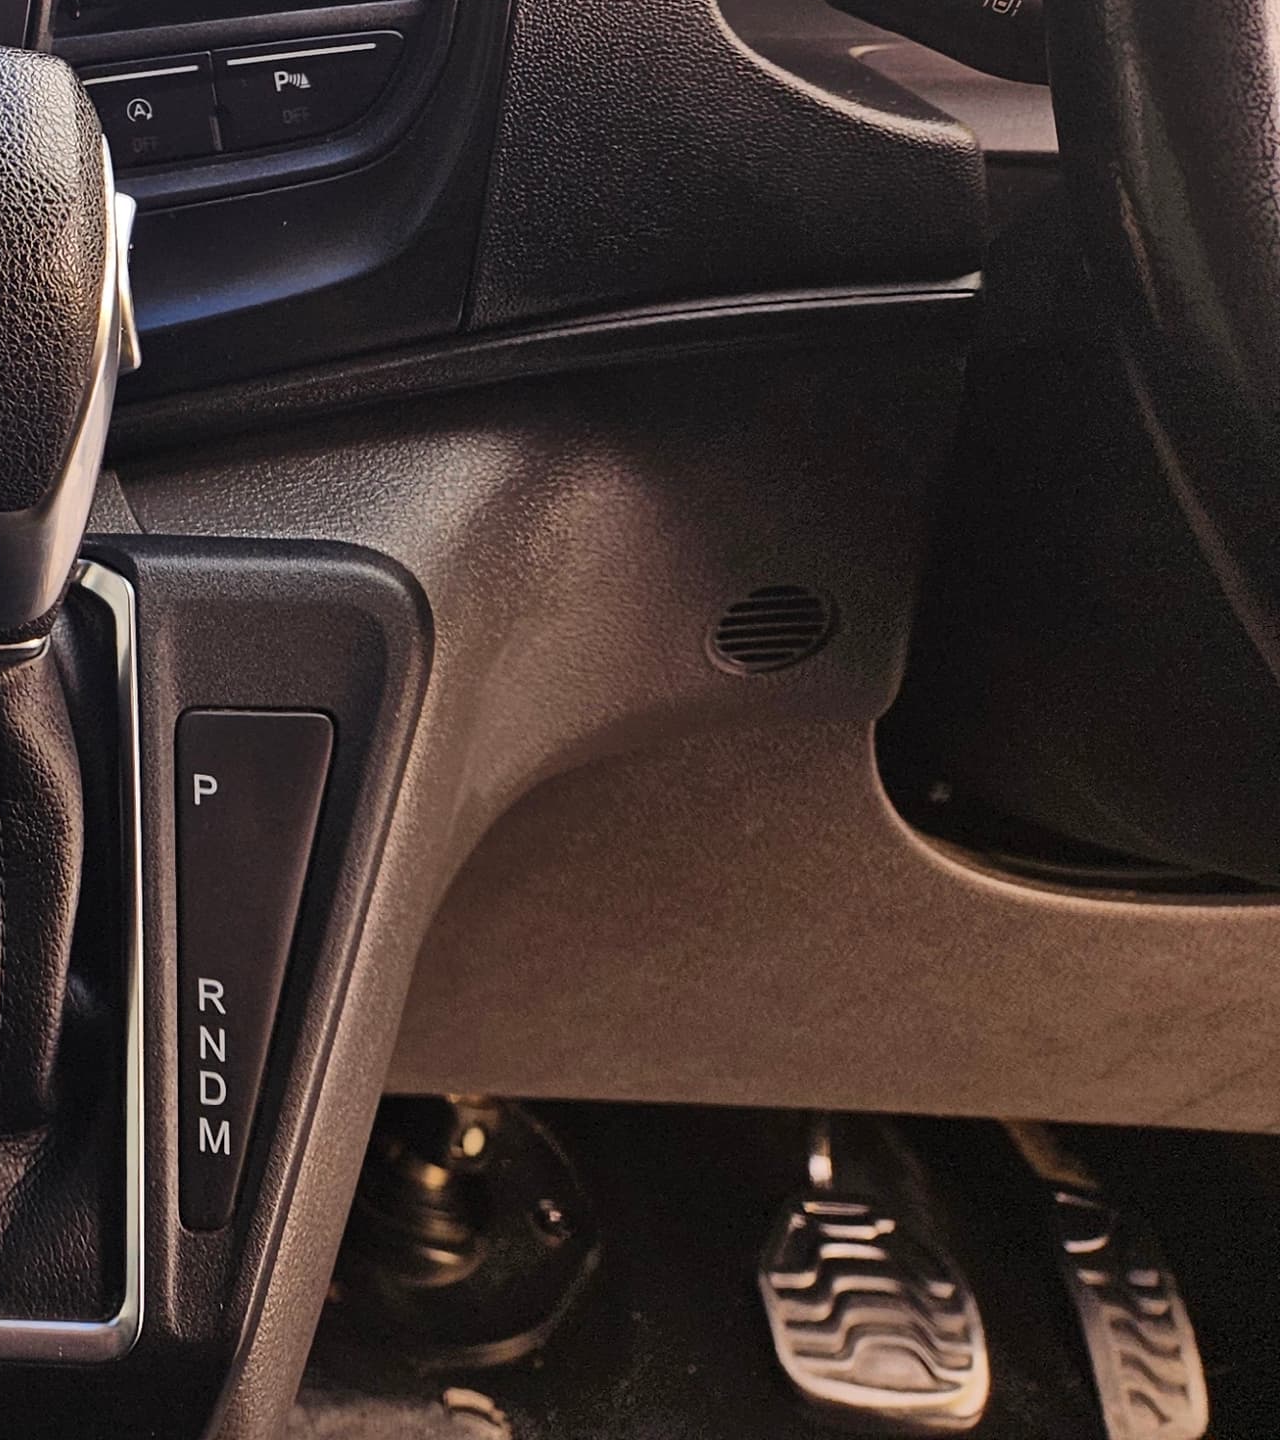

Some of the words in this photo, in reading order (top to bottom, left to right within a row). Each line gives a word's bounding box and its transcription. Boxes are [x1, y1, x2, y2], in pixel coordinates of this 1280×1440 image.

[193, 774, 217, 804] P
[198, 978, 225, 1014] R
[199, 1026, 225, 1062] N
[200, 1071, 226, 1106] D
[199, 1118, 230, 1155] M
